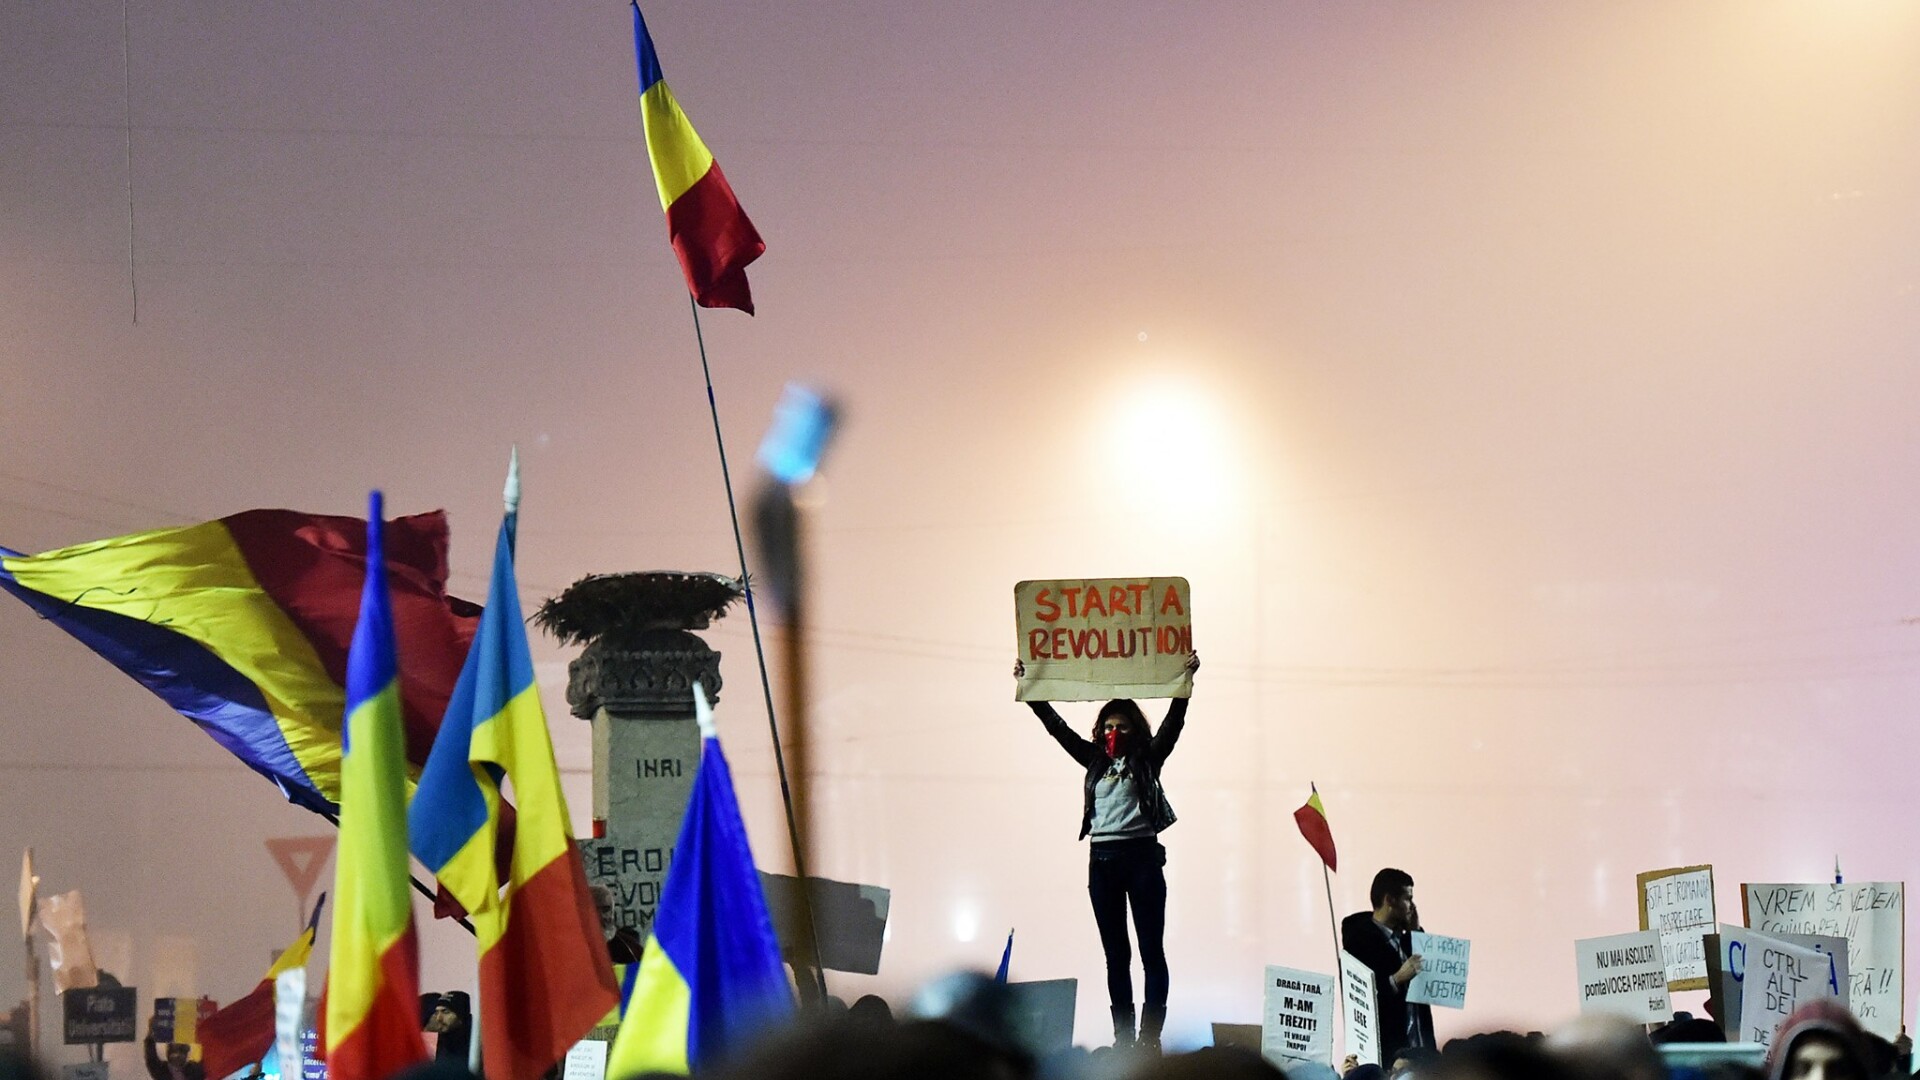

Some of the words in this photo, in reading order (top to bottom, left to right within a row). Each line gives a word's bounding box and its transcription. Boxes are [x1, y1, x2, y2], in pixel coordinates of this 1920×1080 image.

[1035, 583, 1150, 623] START
[1160, 584, 1185, 617] A
[1028, 624, 1193, 661] REVOLUTION
[1667, 882, 1674, 906] E
[1753, 887, 1815, 916] VREM
[1850, 886, 1900, 913] VEDEM
[1596, 951, 1609, 969] NU
[1609, 949, 1623, 967] MAI
[1763, 948, 1809, 981] CTRL
[1766, 971, 1803, 999] ALT
[1283, 996, 1314, 1014] M-AM
[1279, 1013, 1318, 1032] TREZIT!
